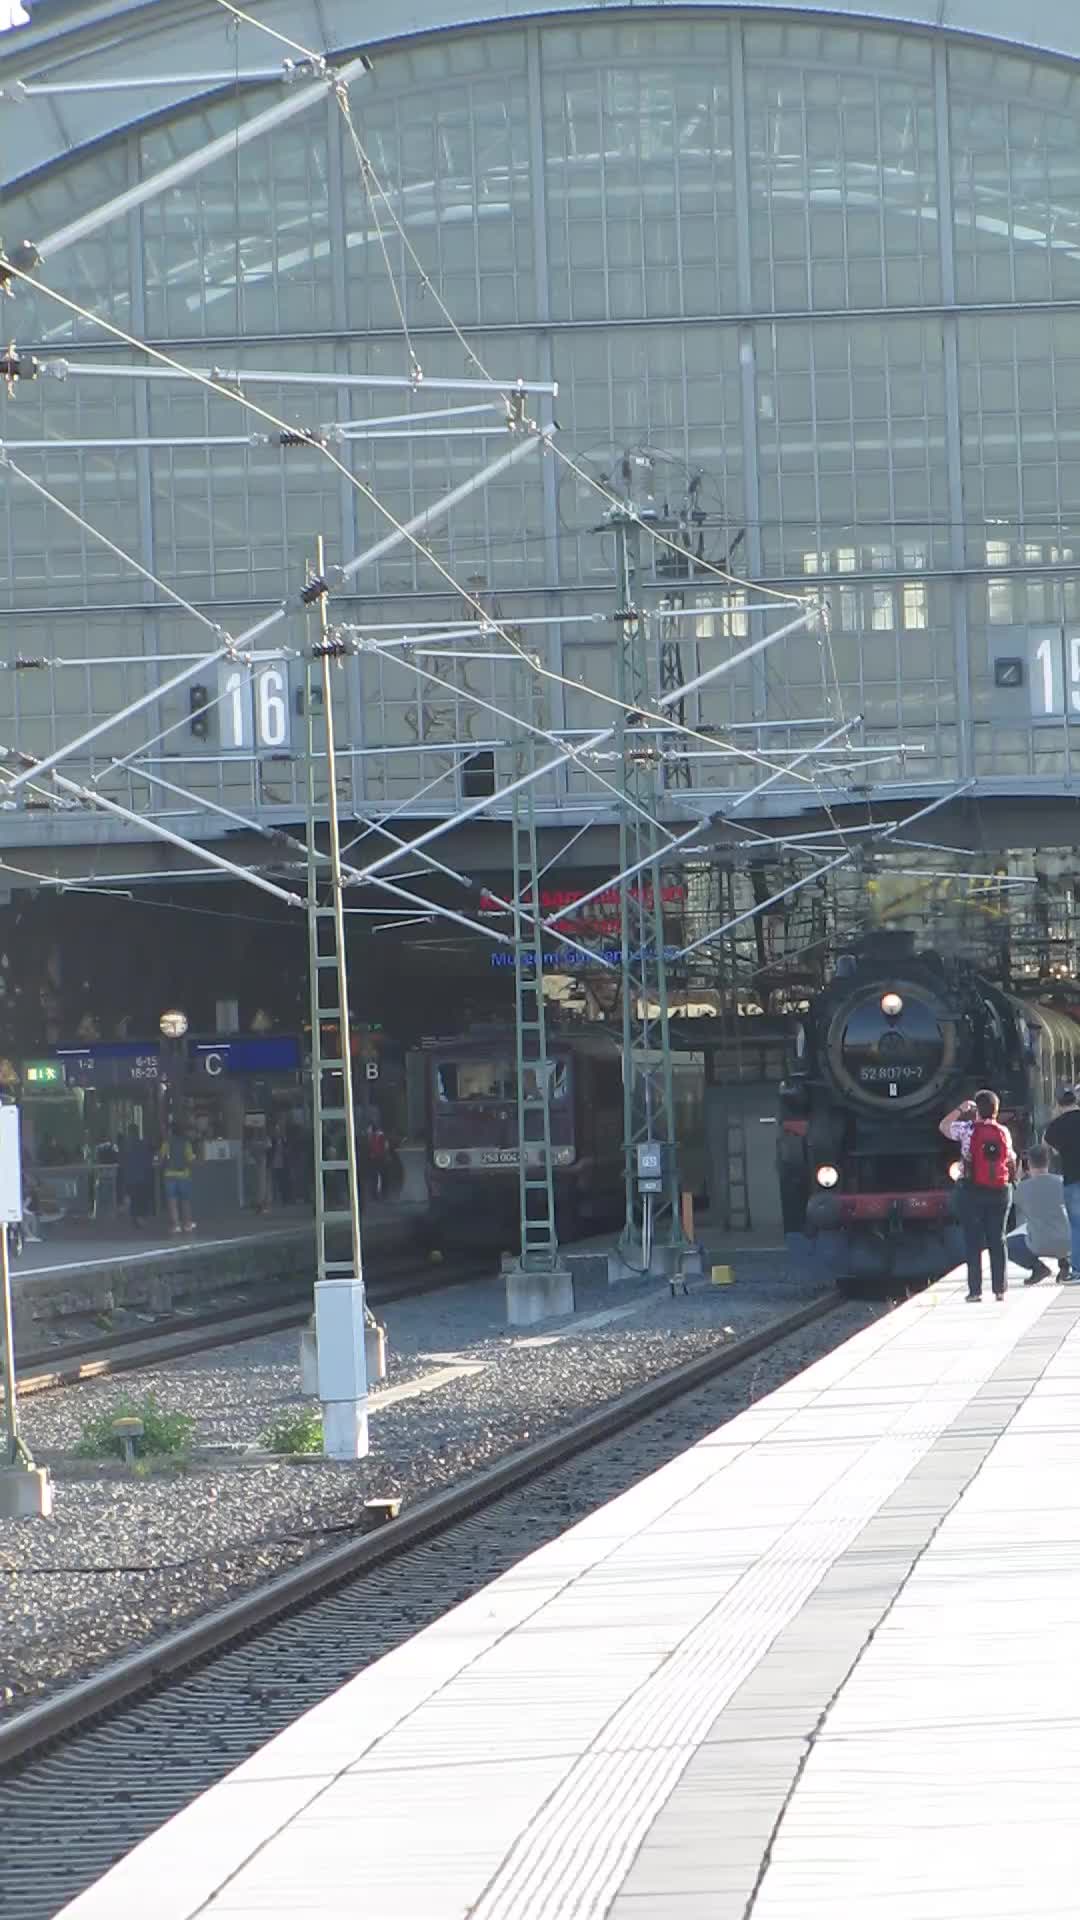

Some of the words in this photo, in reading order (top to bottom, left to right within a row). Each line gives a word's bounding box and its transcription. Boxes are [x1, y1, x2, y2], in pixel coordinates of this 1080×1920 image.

[226, 670, 285, 746] 16
[491, 951, 561, 967] Muem
[205, 1054, 223, 1076] C
[366, 1063, 379, 1080] B
[861, 1067, 876, 1080] 52
